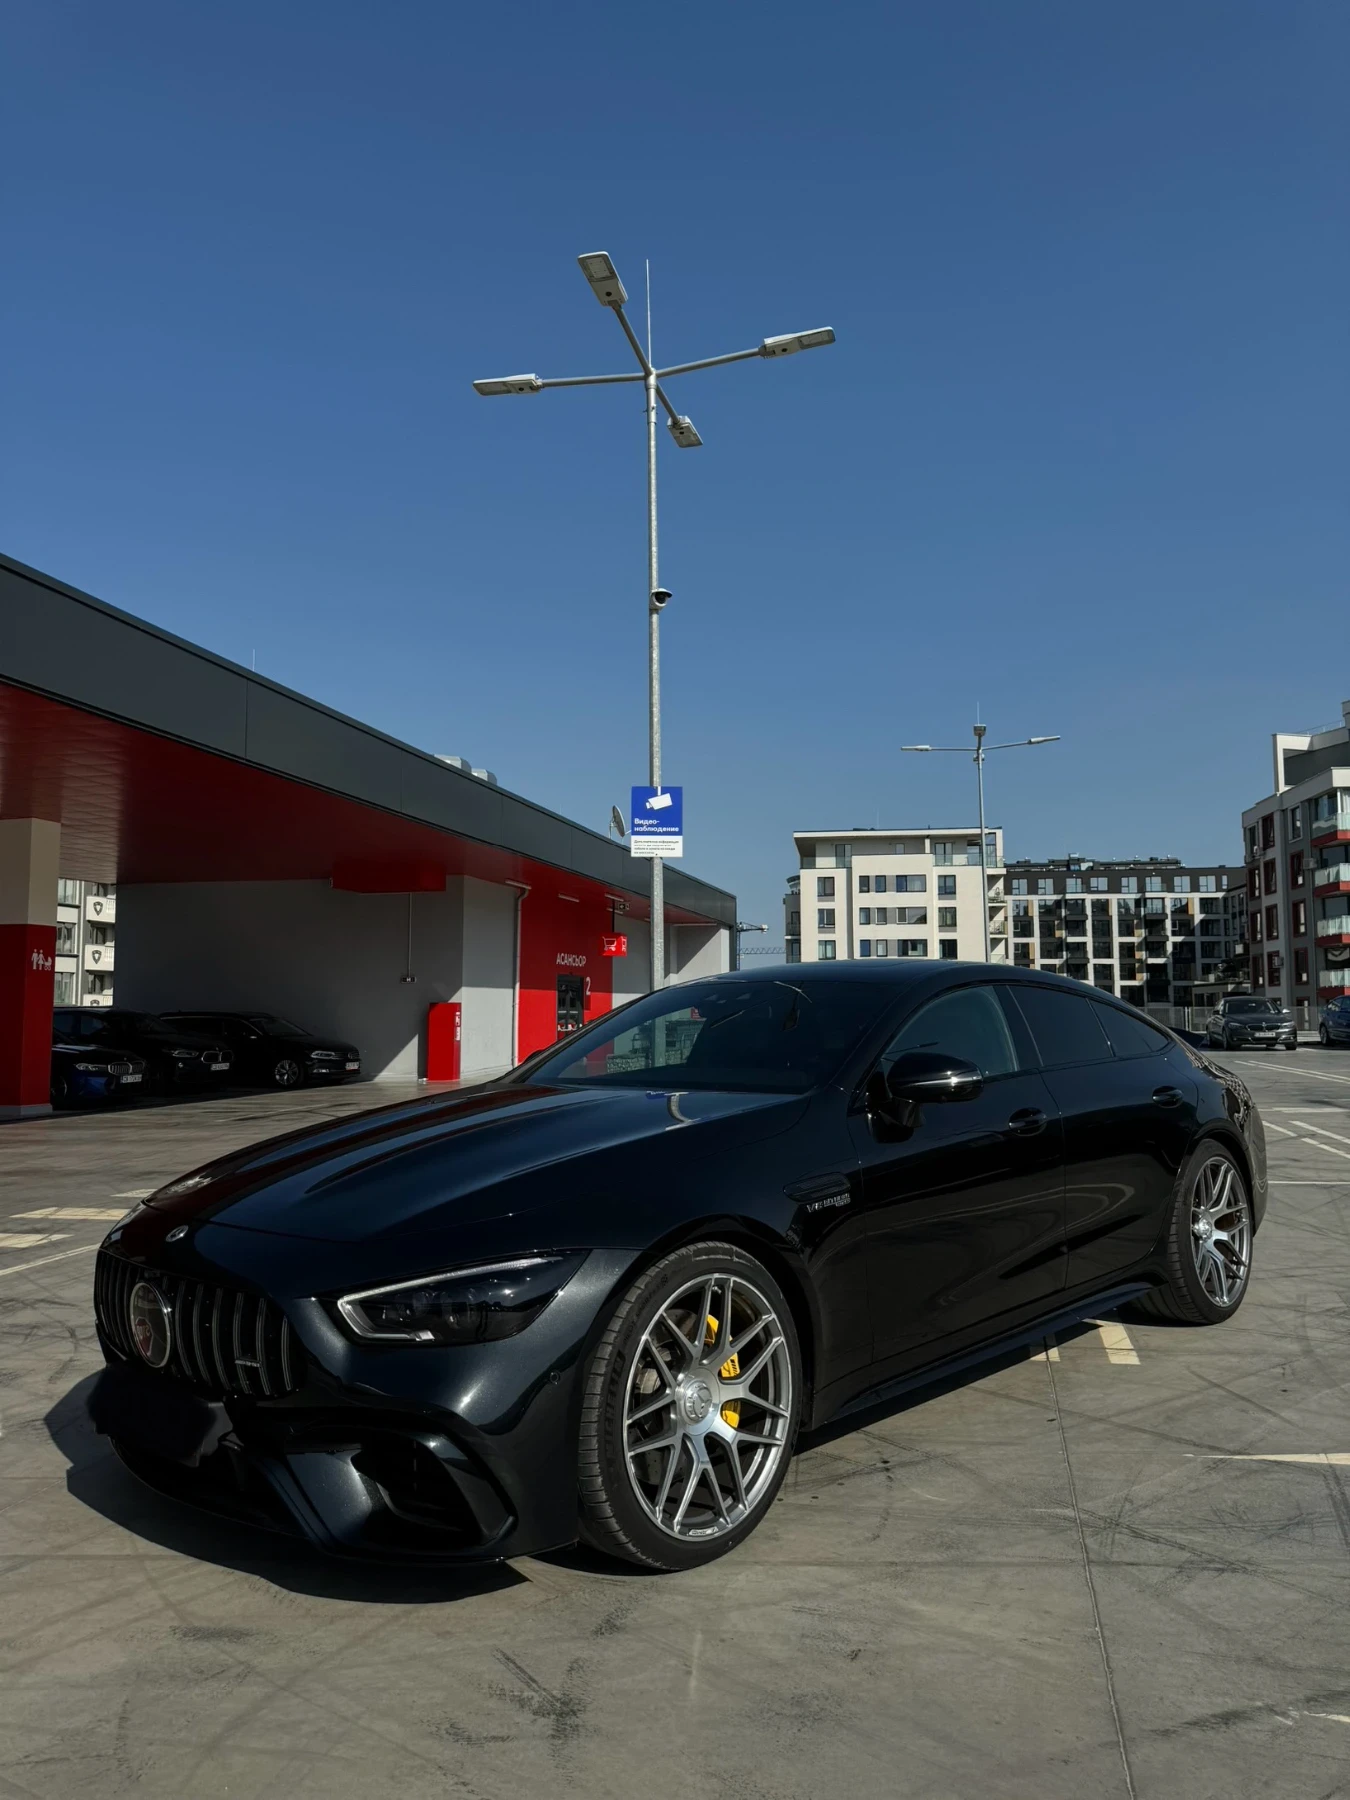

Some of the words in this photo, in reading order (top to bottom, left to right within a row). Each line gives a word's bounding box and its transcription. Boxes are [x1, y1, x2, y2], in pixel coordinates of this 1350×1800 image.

[634, 817, 660, 826] Видео-
[634, 825, 680, 833] наблюдение
[556, 952, 587, 967] АСАНСЬОР
[585, 976, 591, 996] 2
